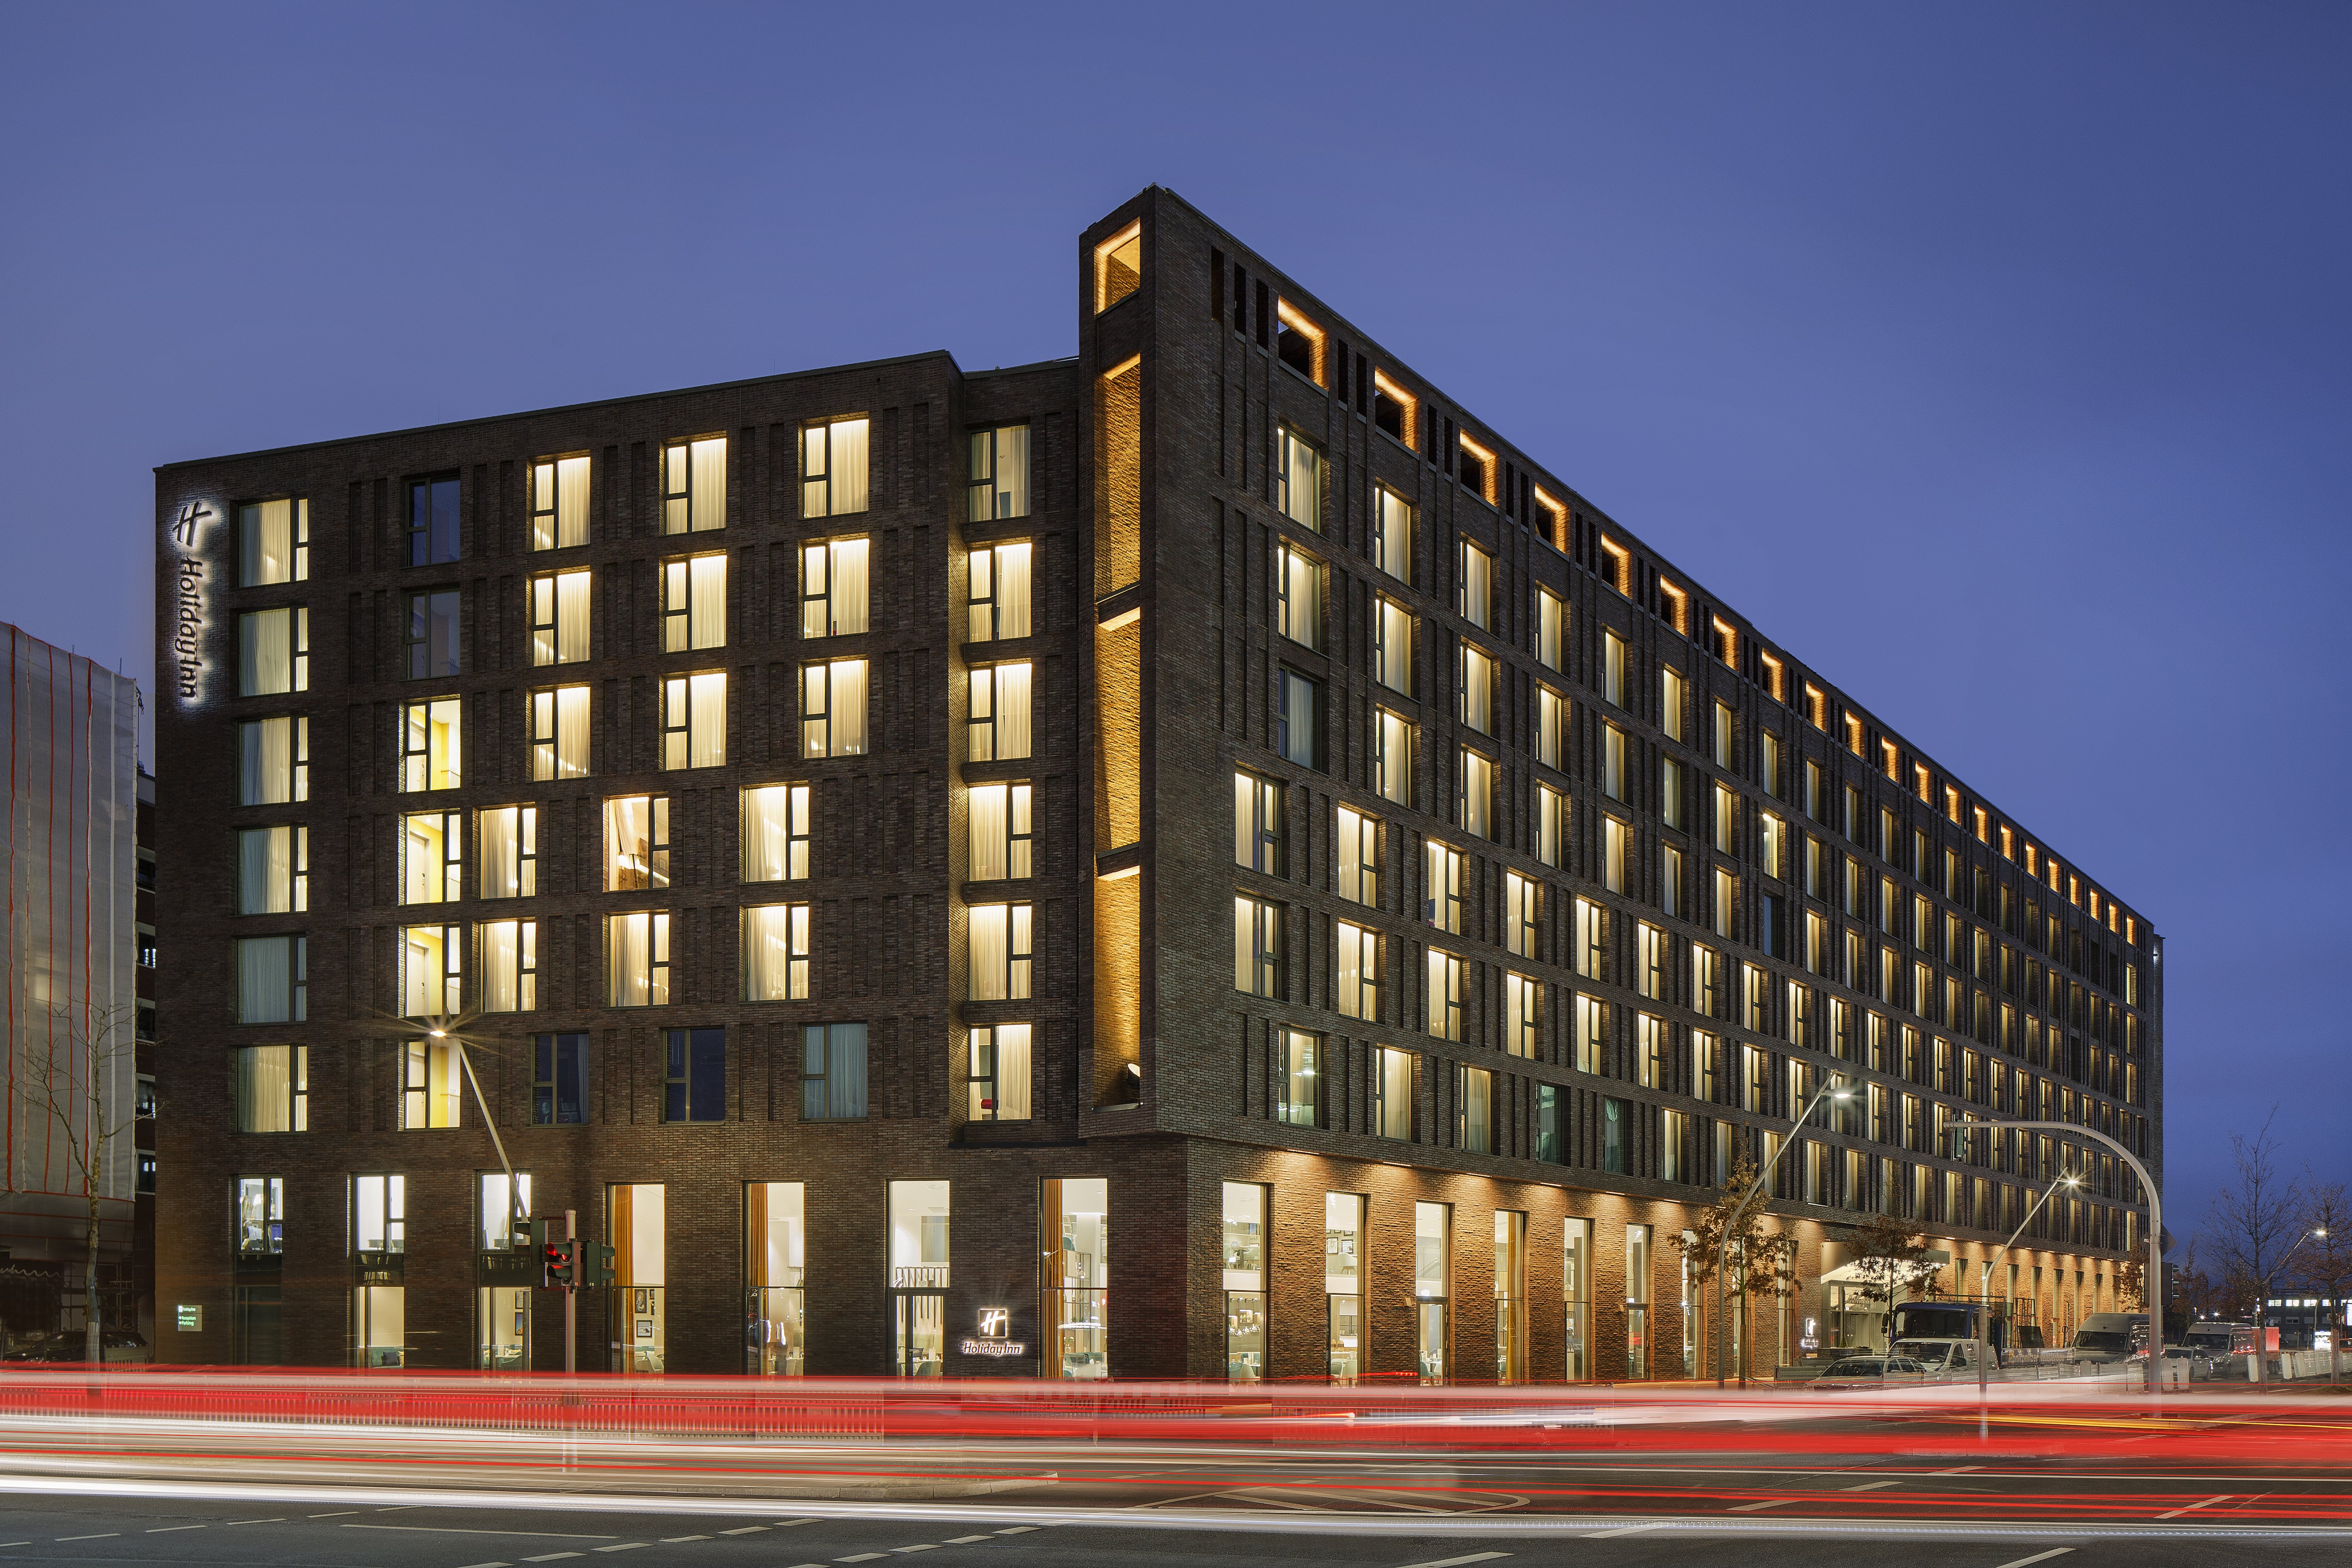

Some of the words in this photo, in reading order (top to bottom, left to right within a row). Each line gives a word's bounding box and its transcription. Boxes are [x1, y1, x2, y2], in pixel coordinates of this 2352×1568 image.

[175, 556, 203, 655] Holiday
[180, 655, 203, 697] Inn
[963, 1343, 1002, 1356] Holiday
[1004, 1343, 1020, 1353] Inn
